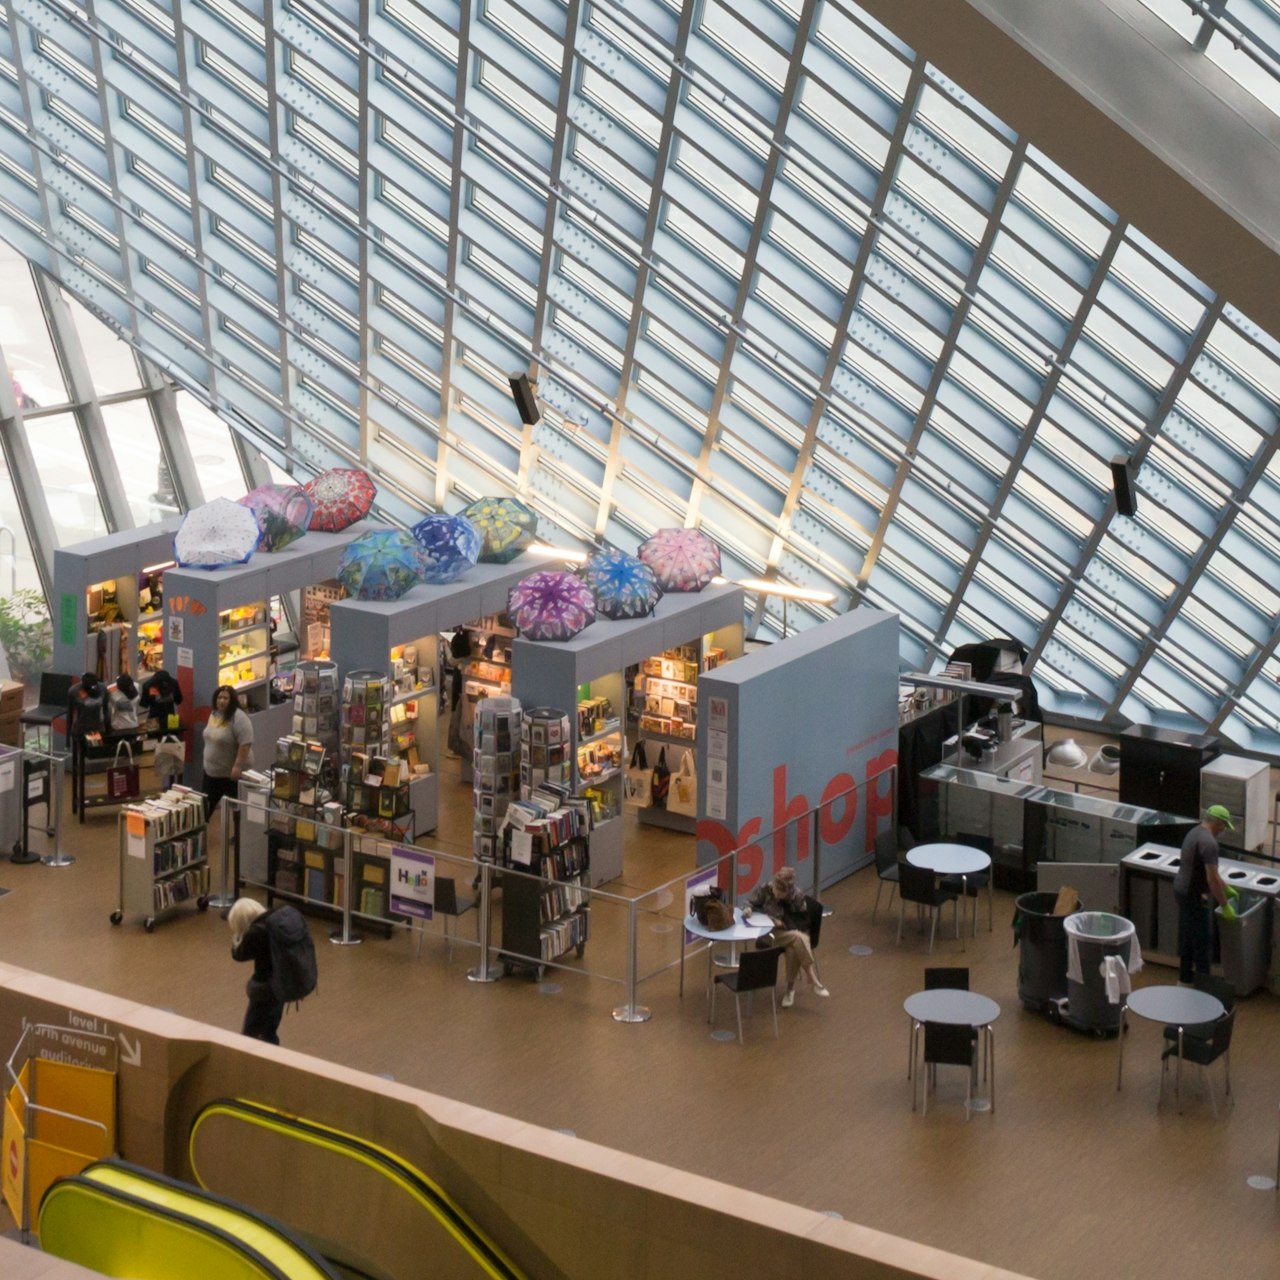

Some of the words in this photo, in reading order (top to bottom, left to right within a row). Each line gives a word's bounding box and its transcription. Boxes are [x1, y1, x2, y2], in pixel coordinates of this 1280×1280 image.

[735, 747, 899, 898] shop
[68, 1010, 98, 1032] level
[61, 1032, 107, 1057] avenue
